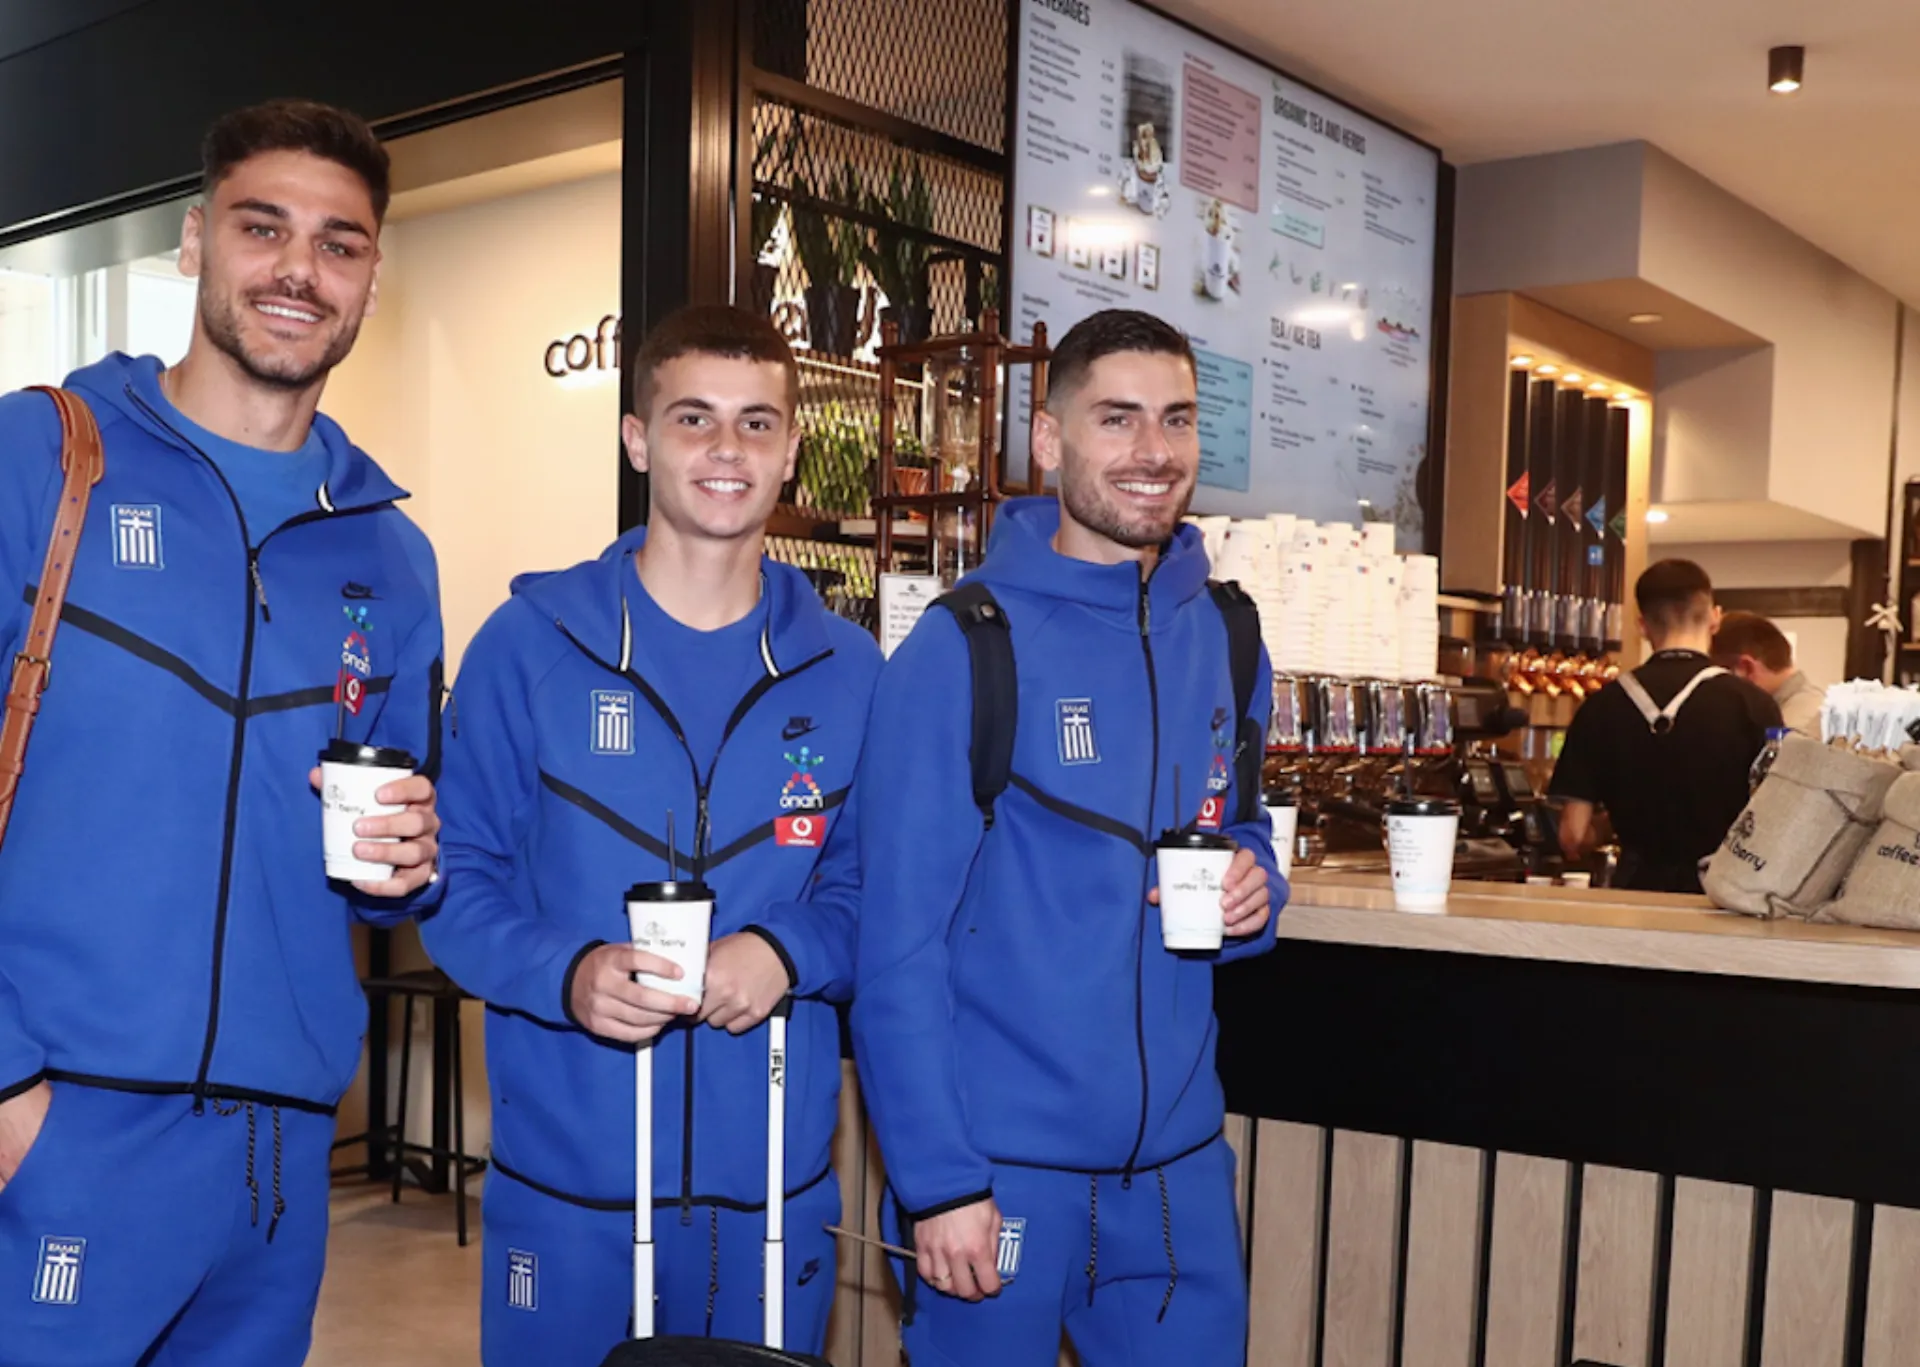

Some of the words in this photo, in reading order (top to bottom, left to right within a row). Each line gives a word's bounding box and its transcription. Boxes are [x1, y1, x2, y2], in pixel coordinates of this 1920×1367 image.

[1031, 0, 1091, 27] ERAGES
[1309, 110, 1324, 135] TEA
[1325, 119, 1341, 144] AND
[1270, 316, 1285, 339] TEA
[1306, 328, 1322, 351] TEA
[1732, 841, 1767, 872] berry
[1877, 843, 1920, 866] coffee
